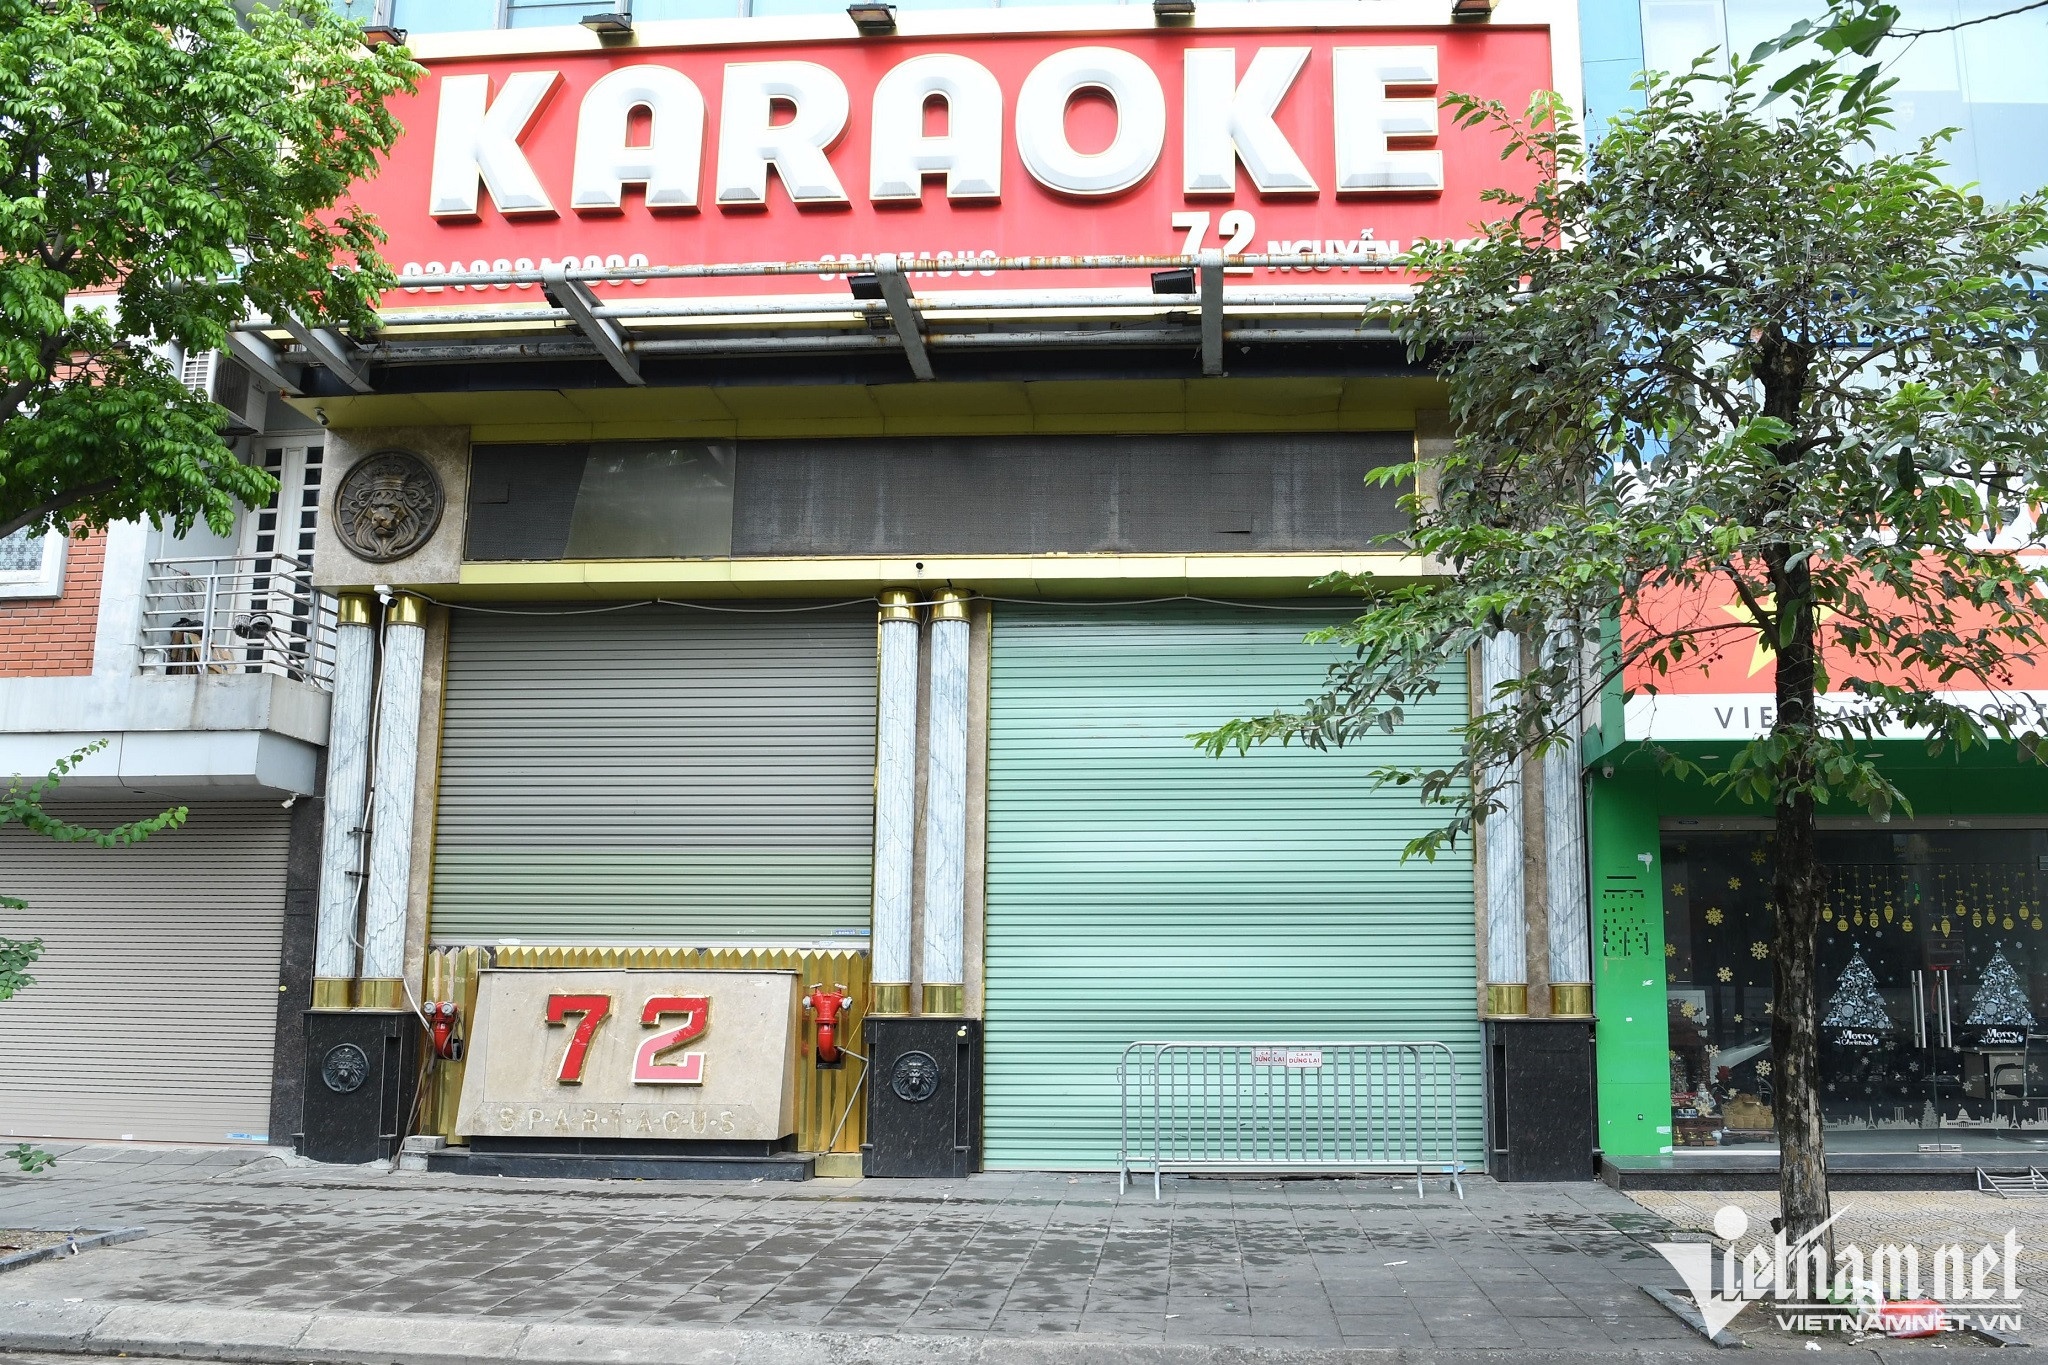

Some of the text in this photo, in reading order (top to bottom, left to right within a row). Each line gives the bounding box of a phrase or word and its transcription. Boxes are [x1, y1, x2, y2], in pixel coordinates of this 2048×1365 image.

[430, 45, 1443, 219] KARAOKE
[1171, 210, 1256, 276] 72
[1266, 228, 1399, 272] NGUYỄN
[1714, 705, 1888, 729] VIEAM
[546, 993, 711, 1086] 72
